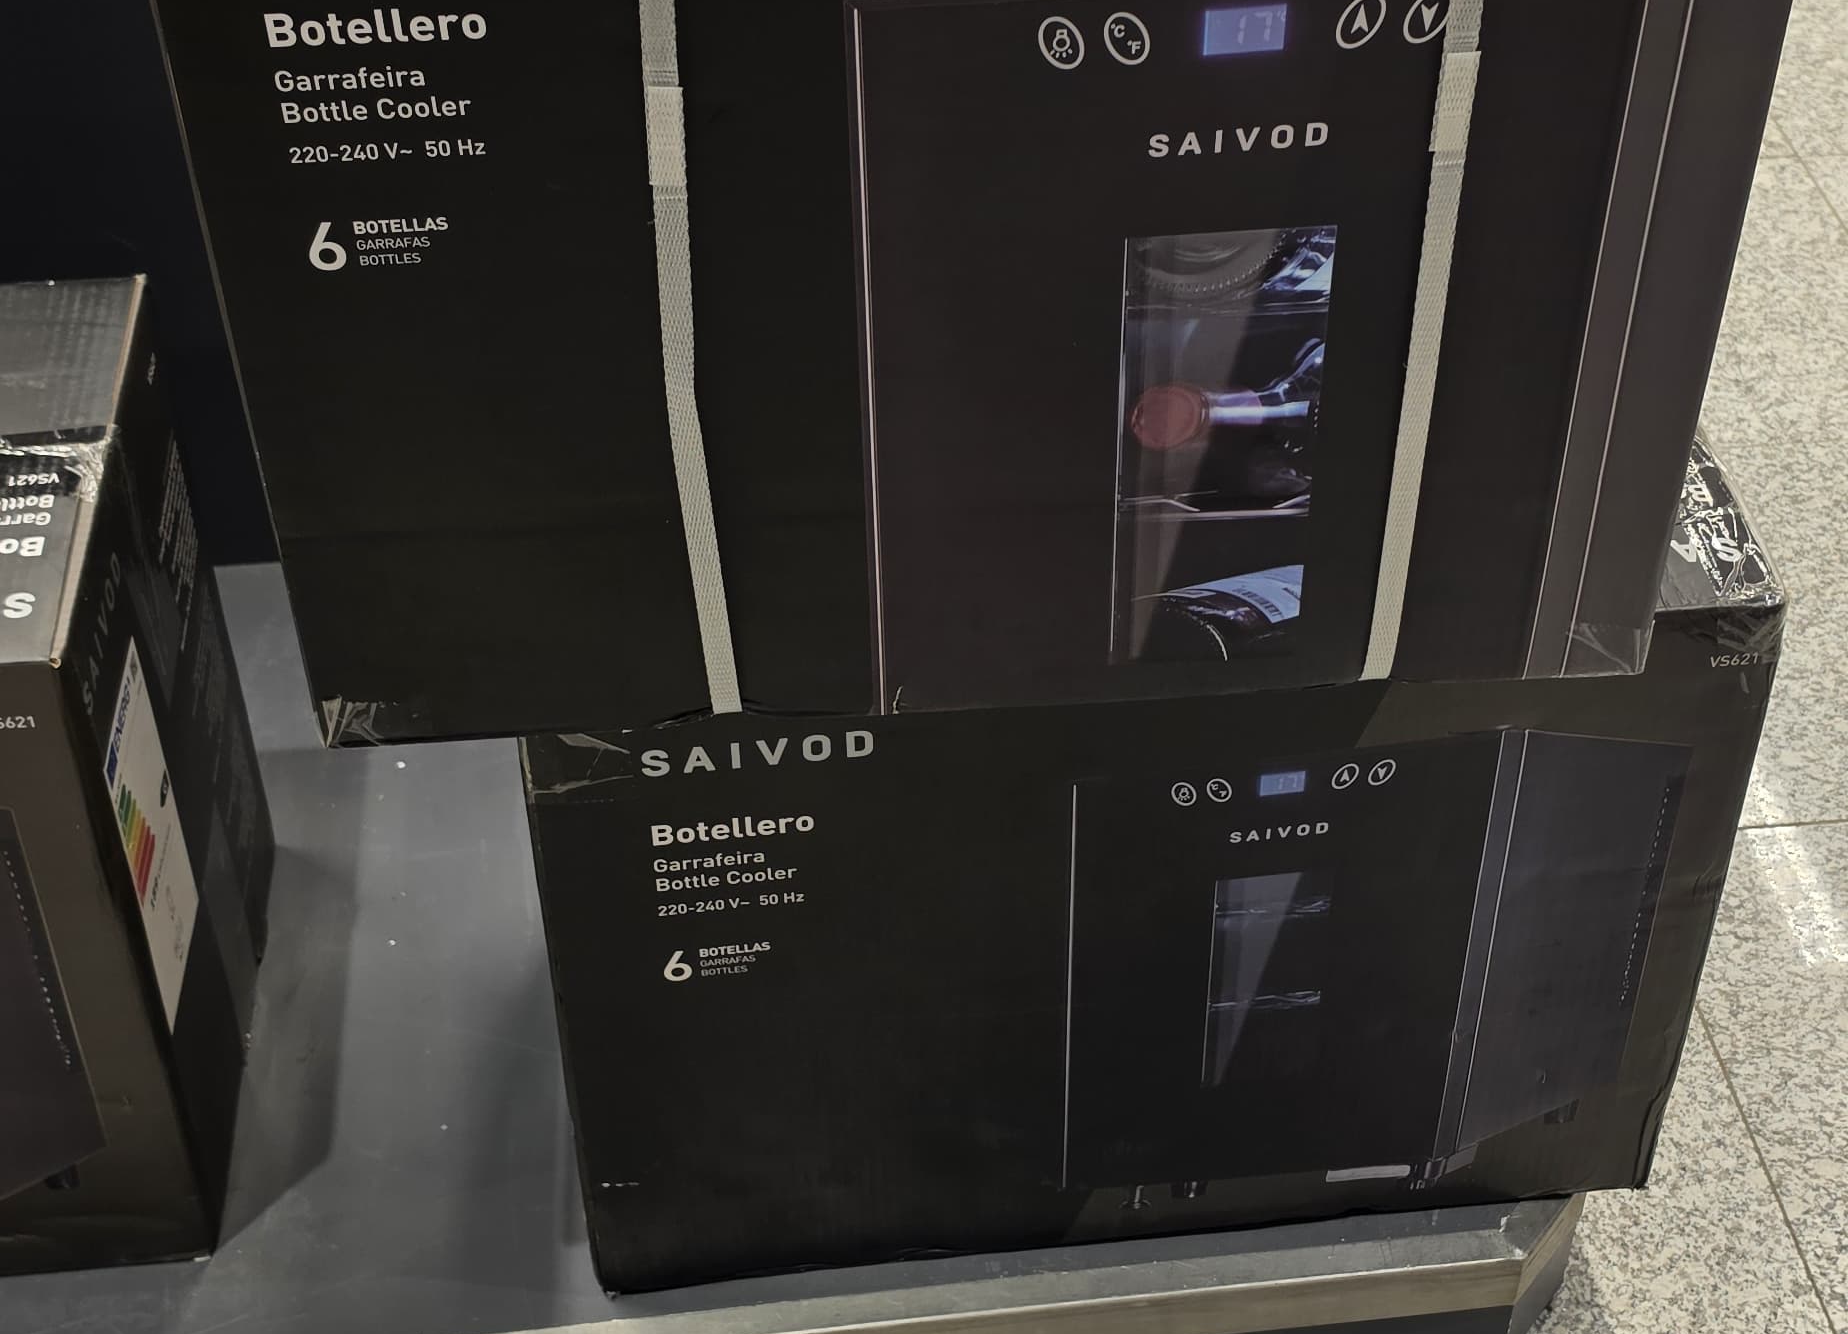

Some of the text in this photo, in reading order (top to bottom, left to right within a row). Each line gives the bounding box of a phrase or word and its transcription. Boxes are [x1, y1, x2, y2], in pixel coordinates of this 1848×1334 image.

[264, 9, 486, 47] Botellero
[275, 66, 425, 92] Garrafeira
[281, 96, 470, 123] Bottle Cooler
[290, 144, 378, 163] 220-240
[425, 140, 450, 157] 50
[458, 139, 485, 155] Hz
[1149, 123, 1328, 157] SAIVOD
[353, 217, 448, 234] BOTELLAS
[309, 222, 346, 270] 6
[357, 237, 430, 250] GARRAFAS
[360, 253, 421, 265] BOTTLES
[8, 472, 60, 487] VS621
[0, 494, 55, 512] Bottl
[83, 551, 122, 716] SAIVOD
[1711, 652, 1758, 667] VS621
[642, 731, 873, 776] SAIVOD
[651, 816, 814, 846] Botellero
[1230, 823, 1328, 843] SAIVOD
[654, 851, 765, 874] Garrafeira
[656, 868, 797, 891] Bottle Cooler
[658, 900, 724, 916] 220-240
[760, 894, 778, 905] 50
[784, 892, 804, 903] Hz
[699, 942, 771, 957] BOTELLAS
[700, 955, 756, 967] GARRAFAS
[664, 951, 692, 981] 6
[700, 965, 748, 977] BOTTLES
